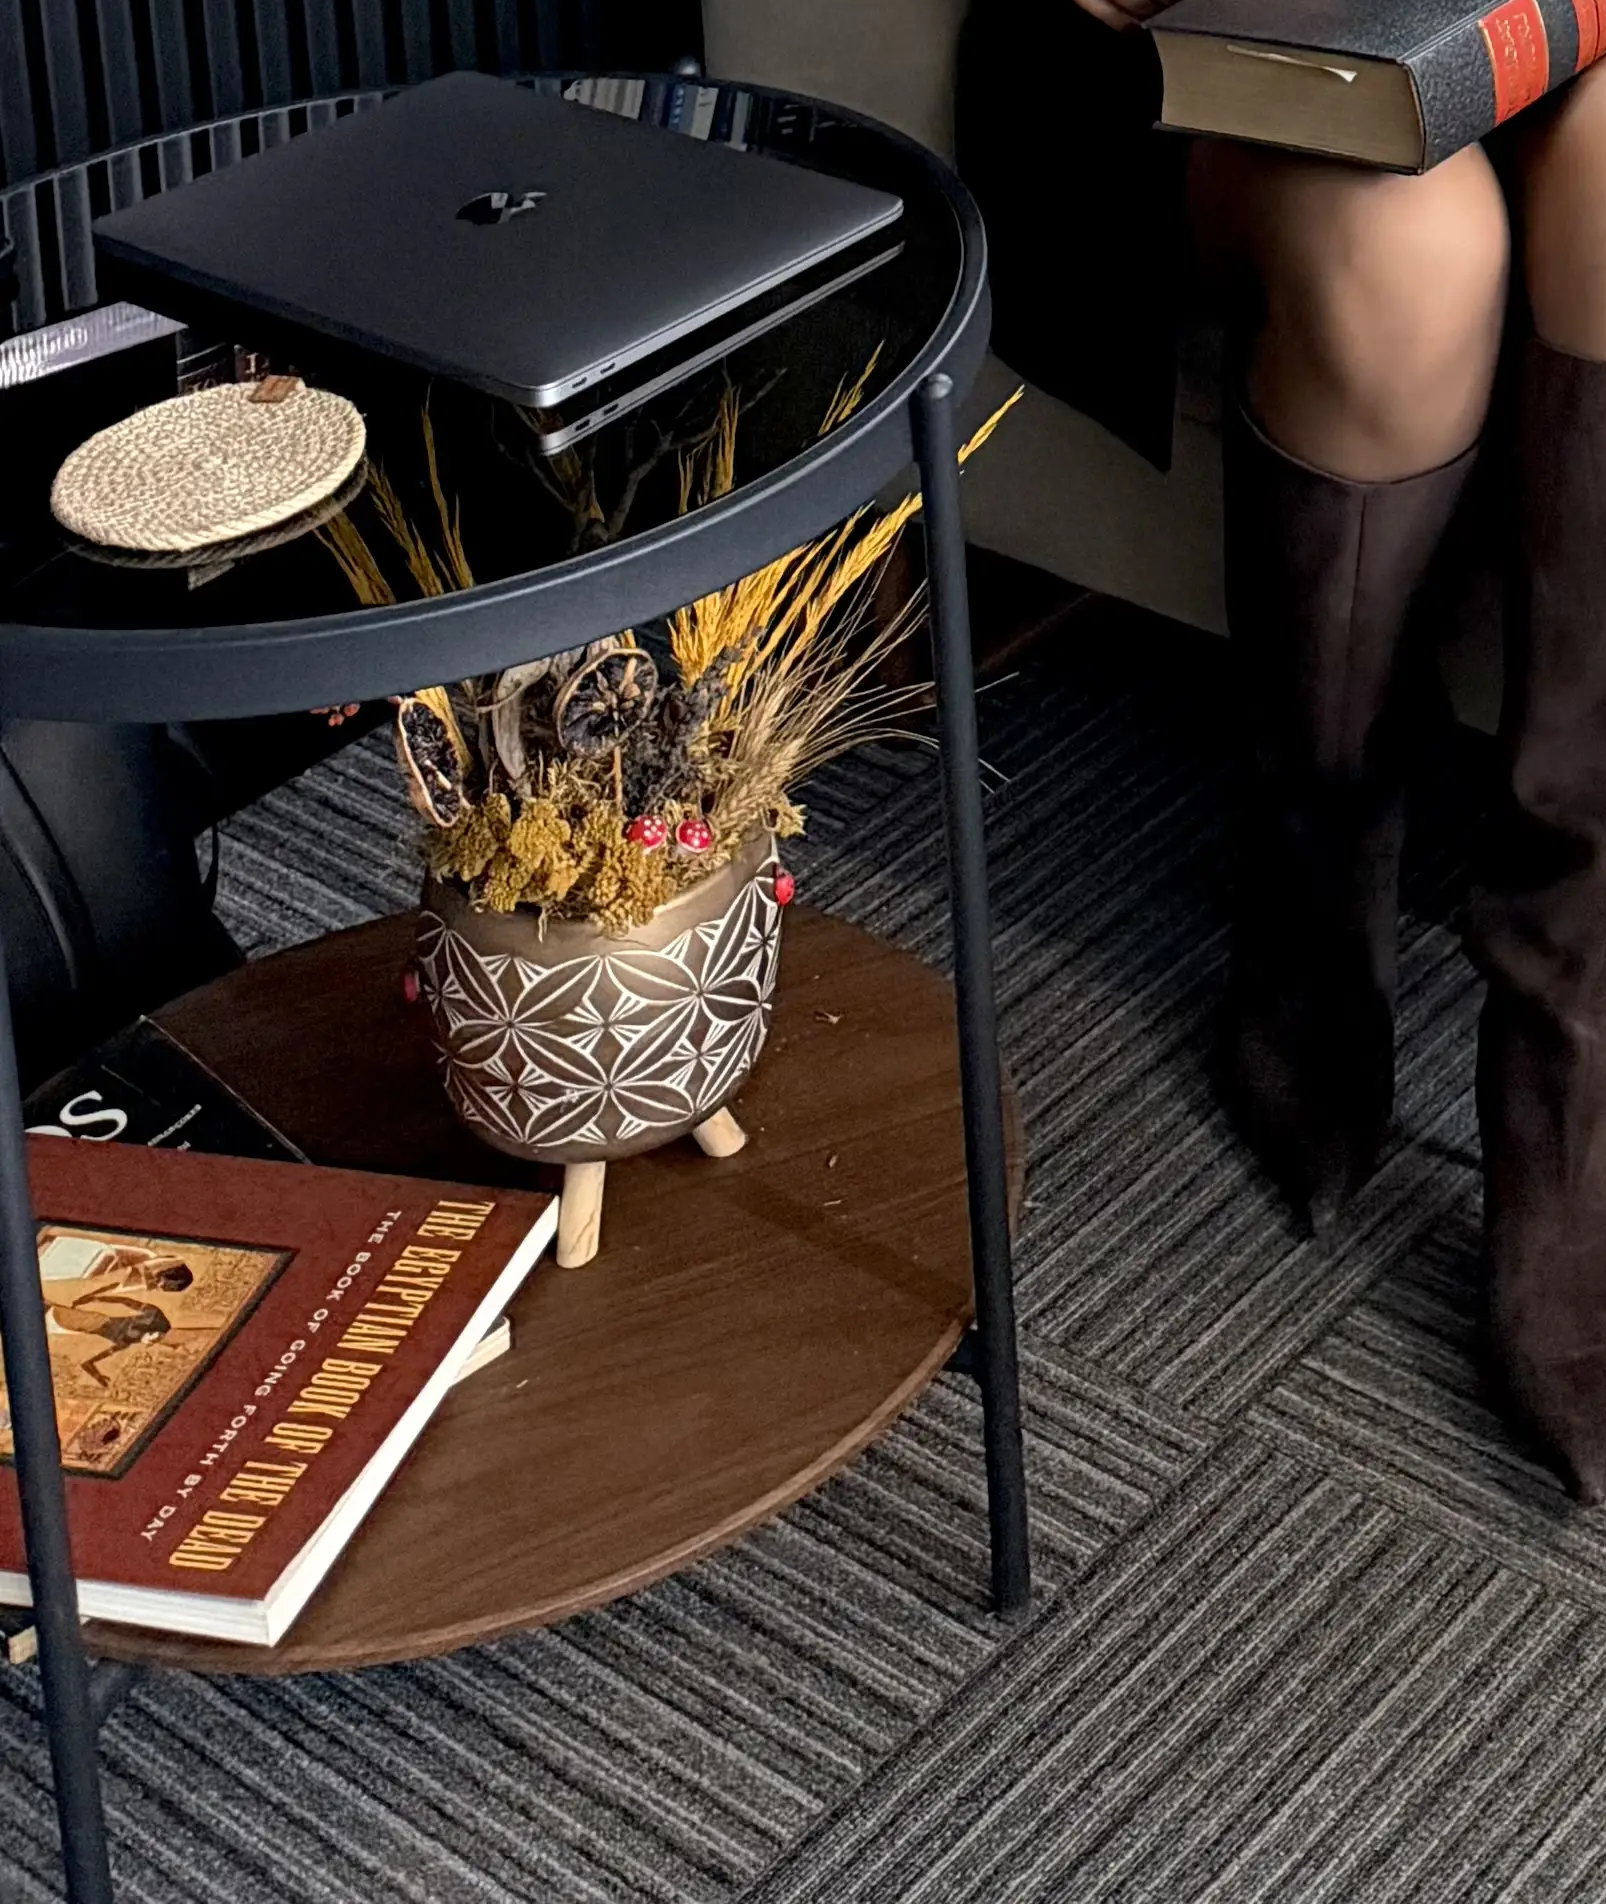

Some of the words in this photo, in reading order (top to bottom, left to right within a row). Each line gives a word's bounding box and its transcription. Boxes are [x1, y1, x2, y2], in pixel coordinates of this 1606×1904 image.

[368, 1210, 402, 1245] THE
[416, 1200, 496, 1241] THE
[326, 1251, 372, 1302] BOOK
[336, 1245, 462, 1354] EGYPTIAN
[306, 1307, 330, 1334] OF
[254, 1339, 306, 1398] GOING
[287, 1358, 383, 1420] BOOK
[199, 1404, 257, 1466] FORTH
[263, 1422, 333, 1454] OF
[176, 1474, 202, 1499] BY
[219, 1460, 308, 1507] THE
[140, 1505, 178, 1542] DAY
[168, 1510, 267, 1571] DEAD
